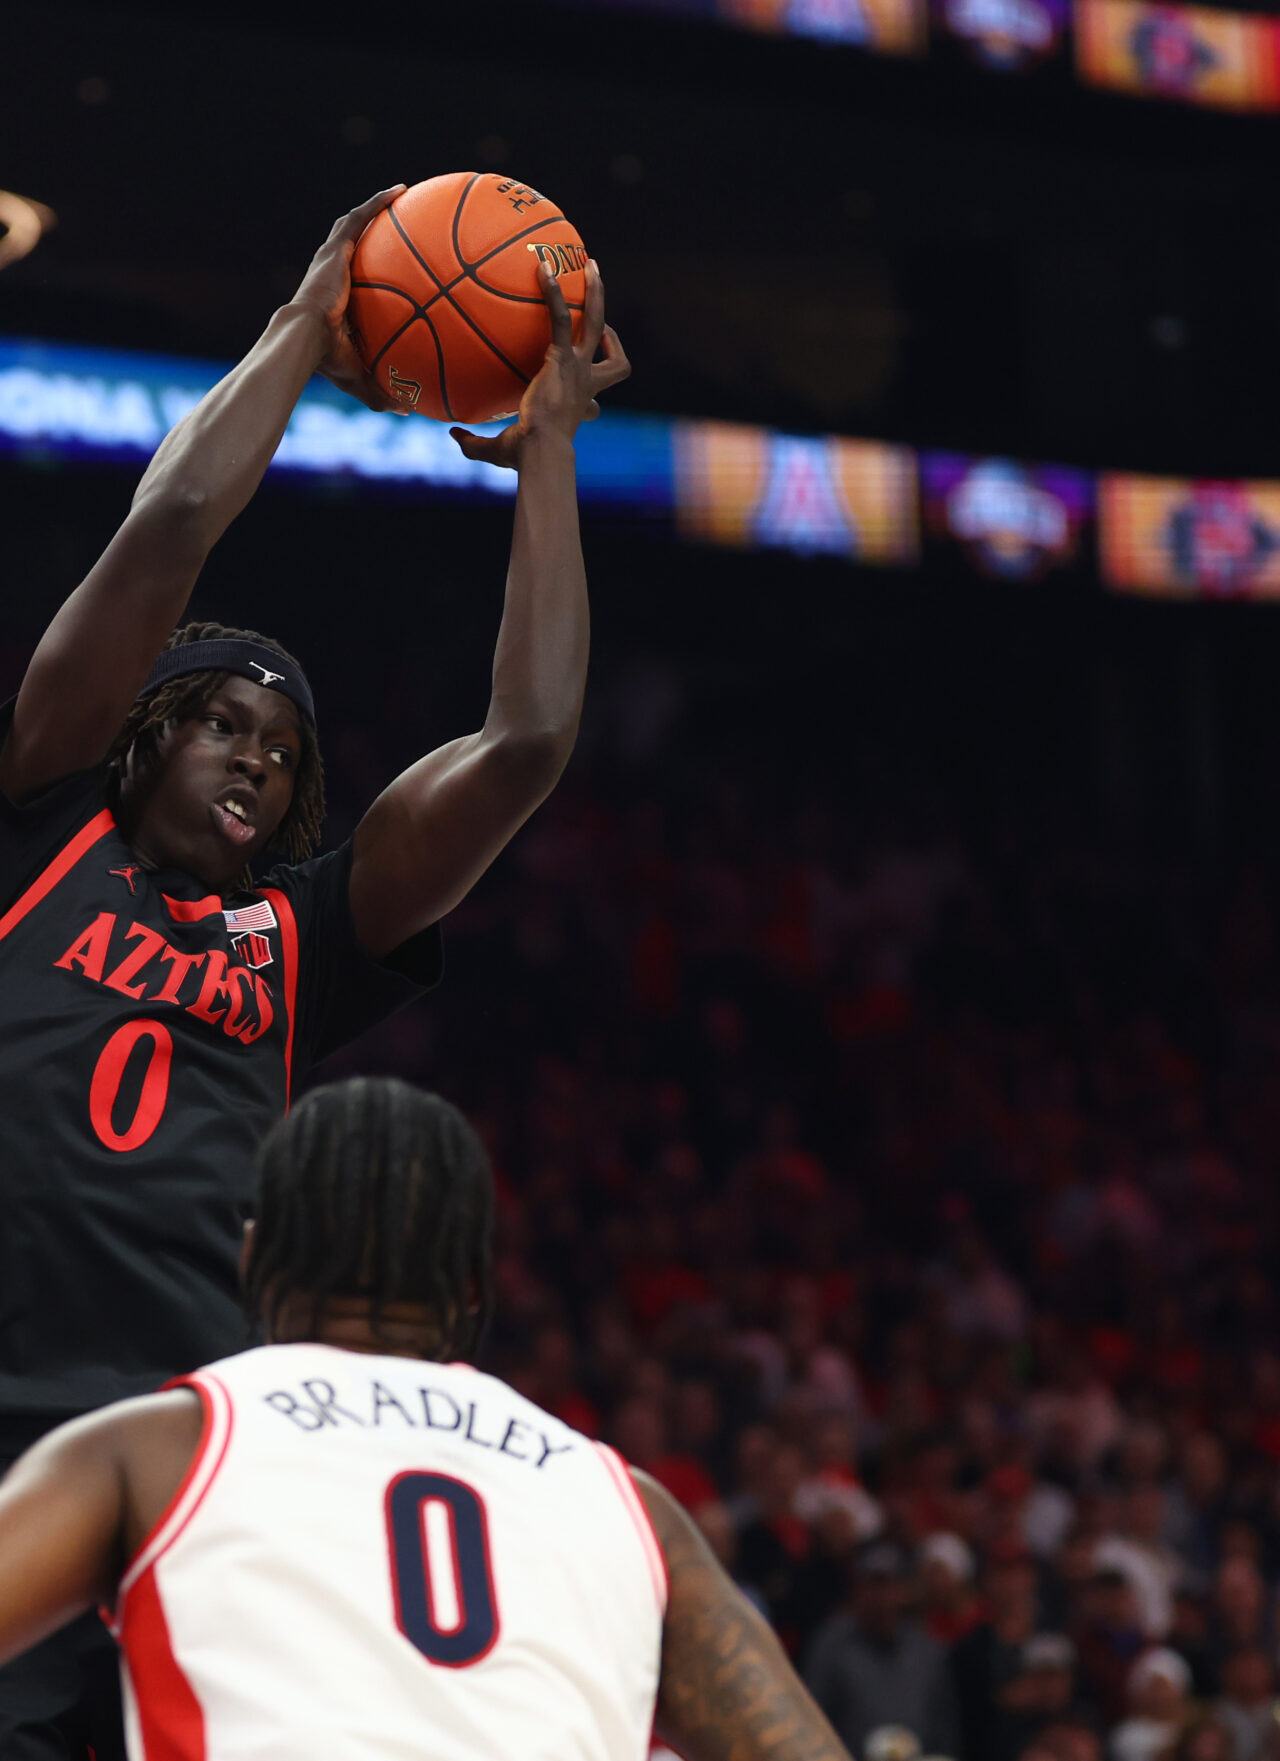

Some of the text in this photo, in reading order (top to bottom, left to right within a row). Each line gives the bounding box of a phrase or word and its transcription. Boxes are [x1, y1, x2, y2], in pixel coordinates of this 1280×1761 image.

[53, 911, 274, 1045] AZTECS
[89, 1018, 173, 1152] 0
[263, 1377, 575, 1470] BRADLEY
[383, 1468, 501, 1670] 0
